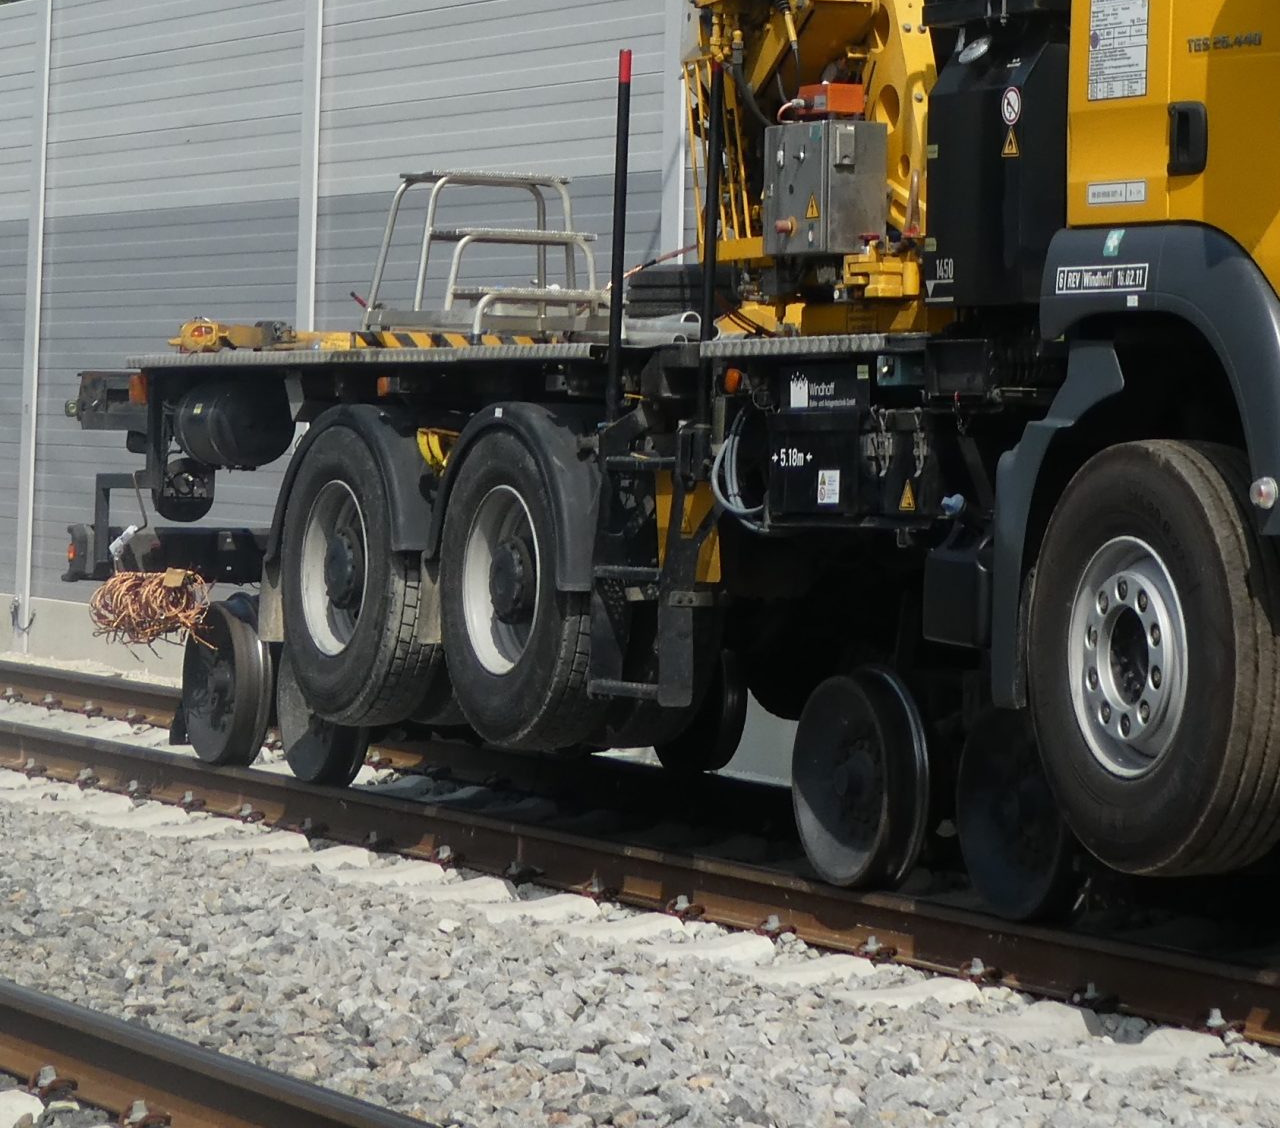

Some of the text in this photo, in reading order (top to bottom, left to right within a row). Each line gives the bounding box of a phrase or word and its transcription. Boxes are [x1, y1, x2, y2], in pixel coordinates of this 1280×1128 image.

[936, 257, 954, 279] 1450
[1067, 271, 1081, 288] REV
[1083, 270, 1112, 287] Windhoff
[809, 381, 835, 396] Windhoff
[780, 447, 804, 467] 5.18m
